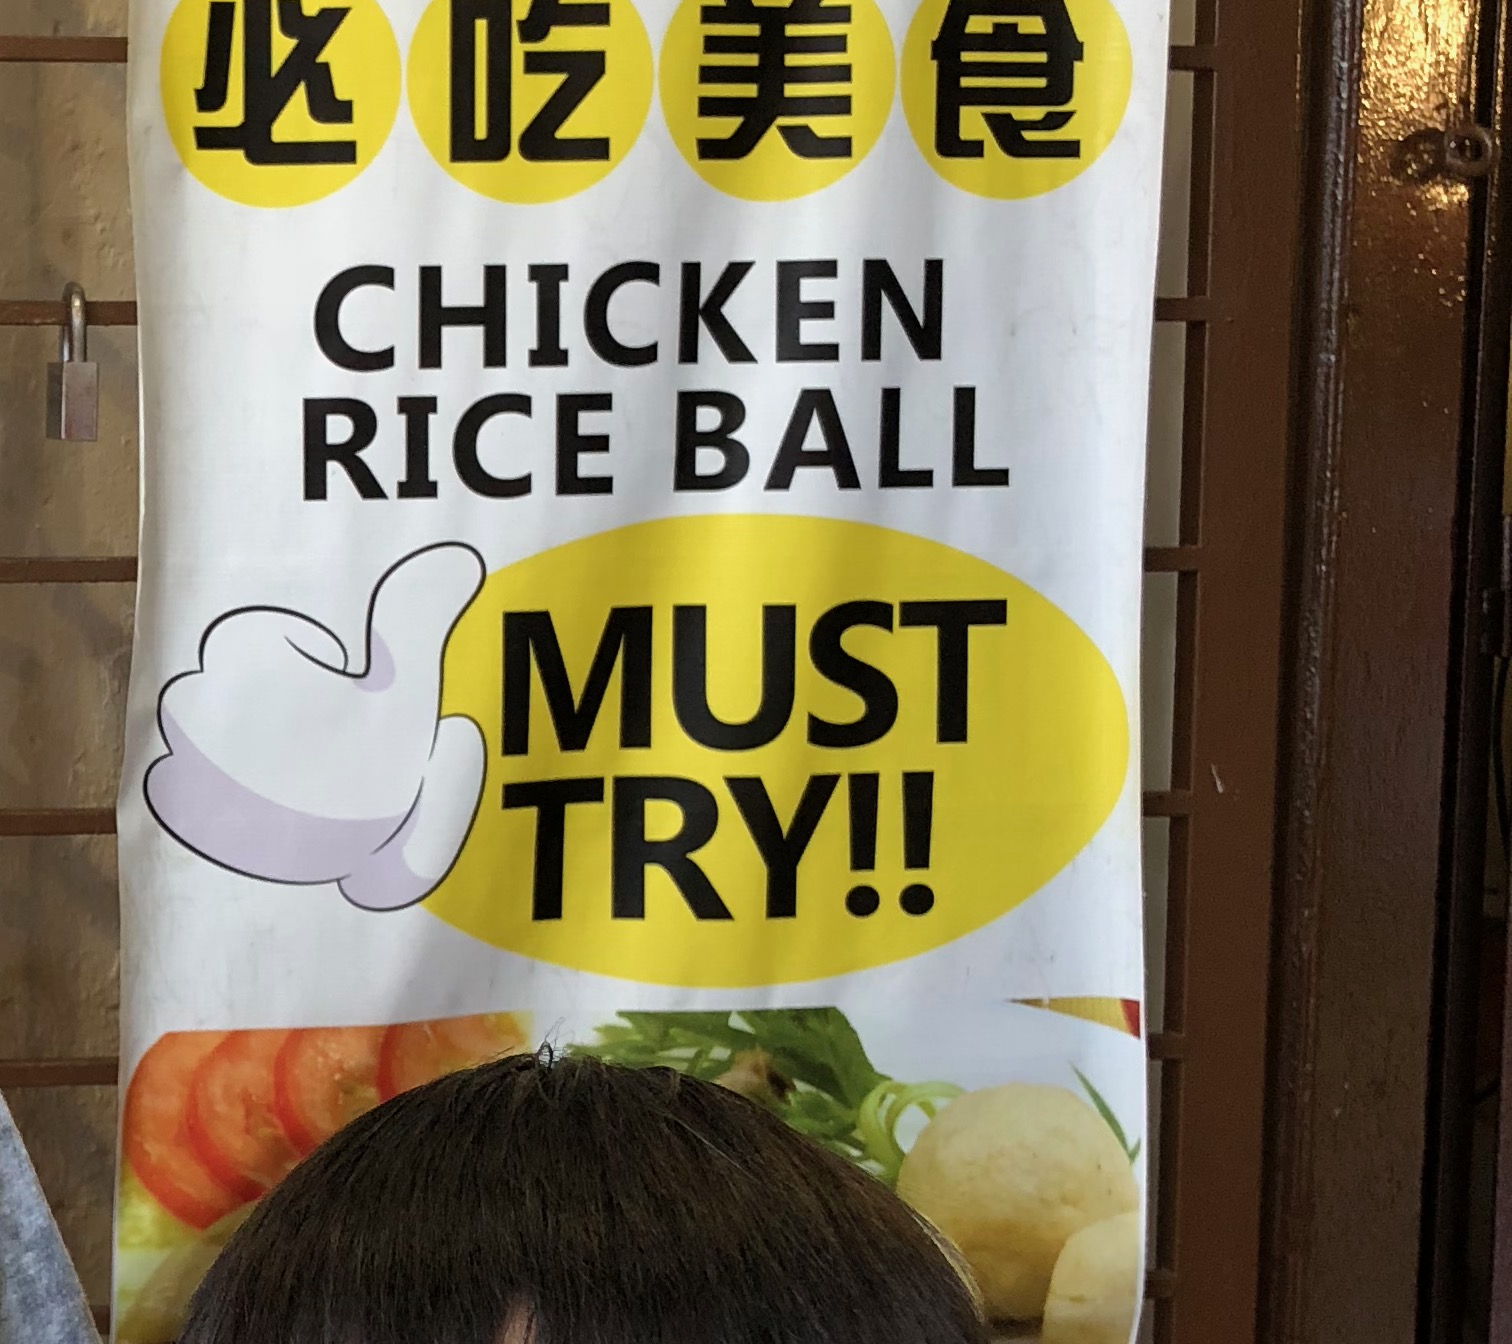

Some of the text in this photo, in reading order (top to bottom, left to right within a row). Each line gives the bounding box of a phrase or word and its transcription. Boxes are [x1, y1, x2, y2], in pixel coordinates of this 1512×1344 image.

[314, 258, 944, 372] CHICKEN
[302, 386, 1011, 502] RICE BALL
[501, 599, 1008, 757] MUST
[502, 771, 936, 921] TRY!!
